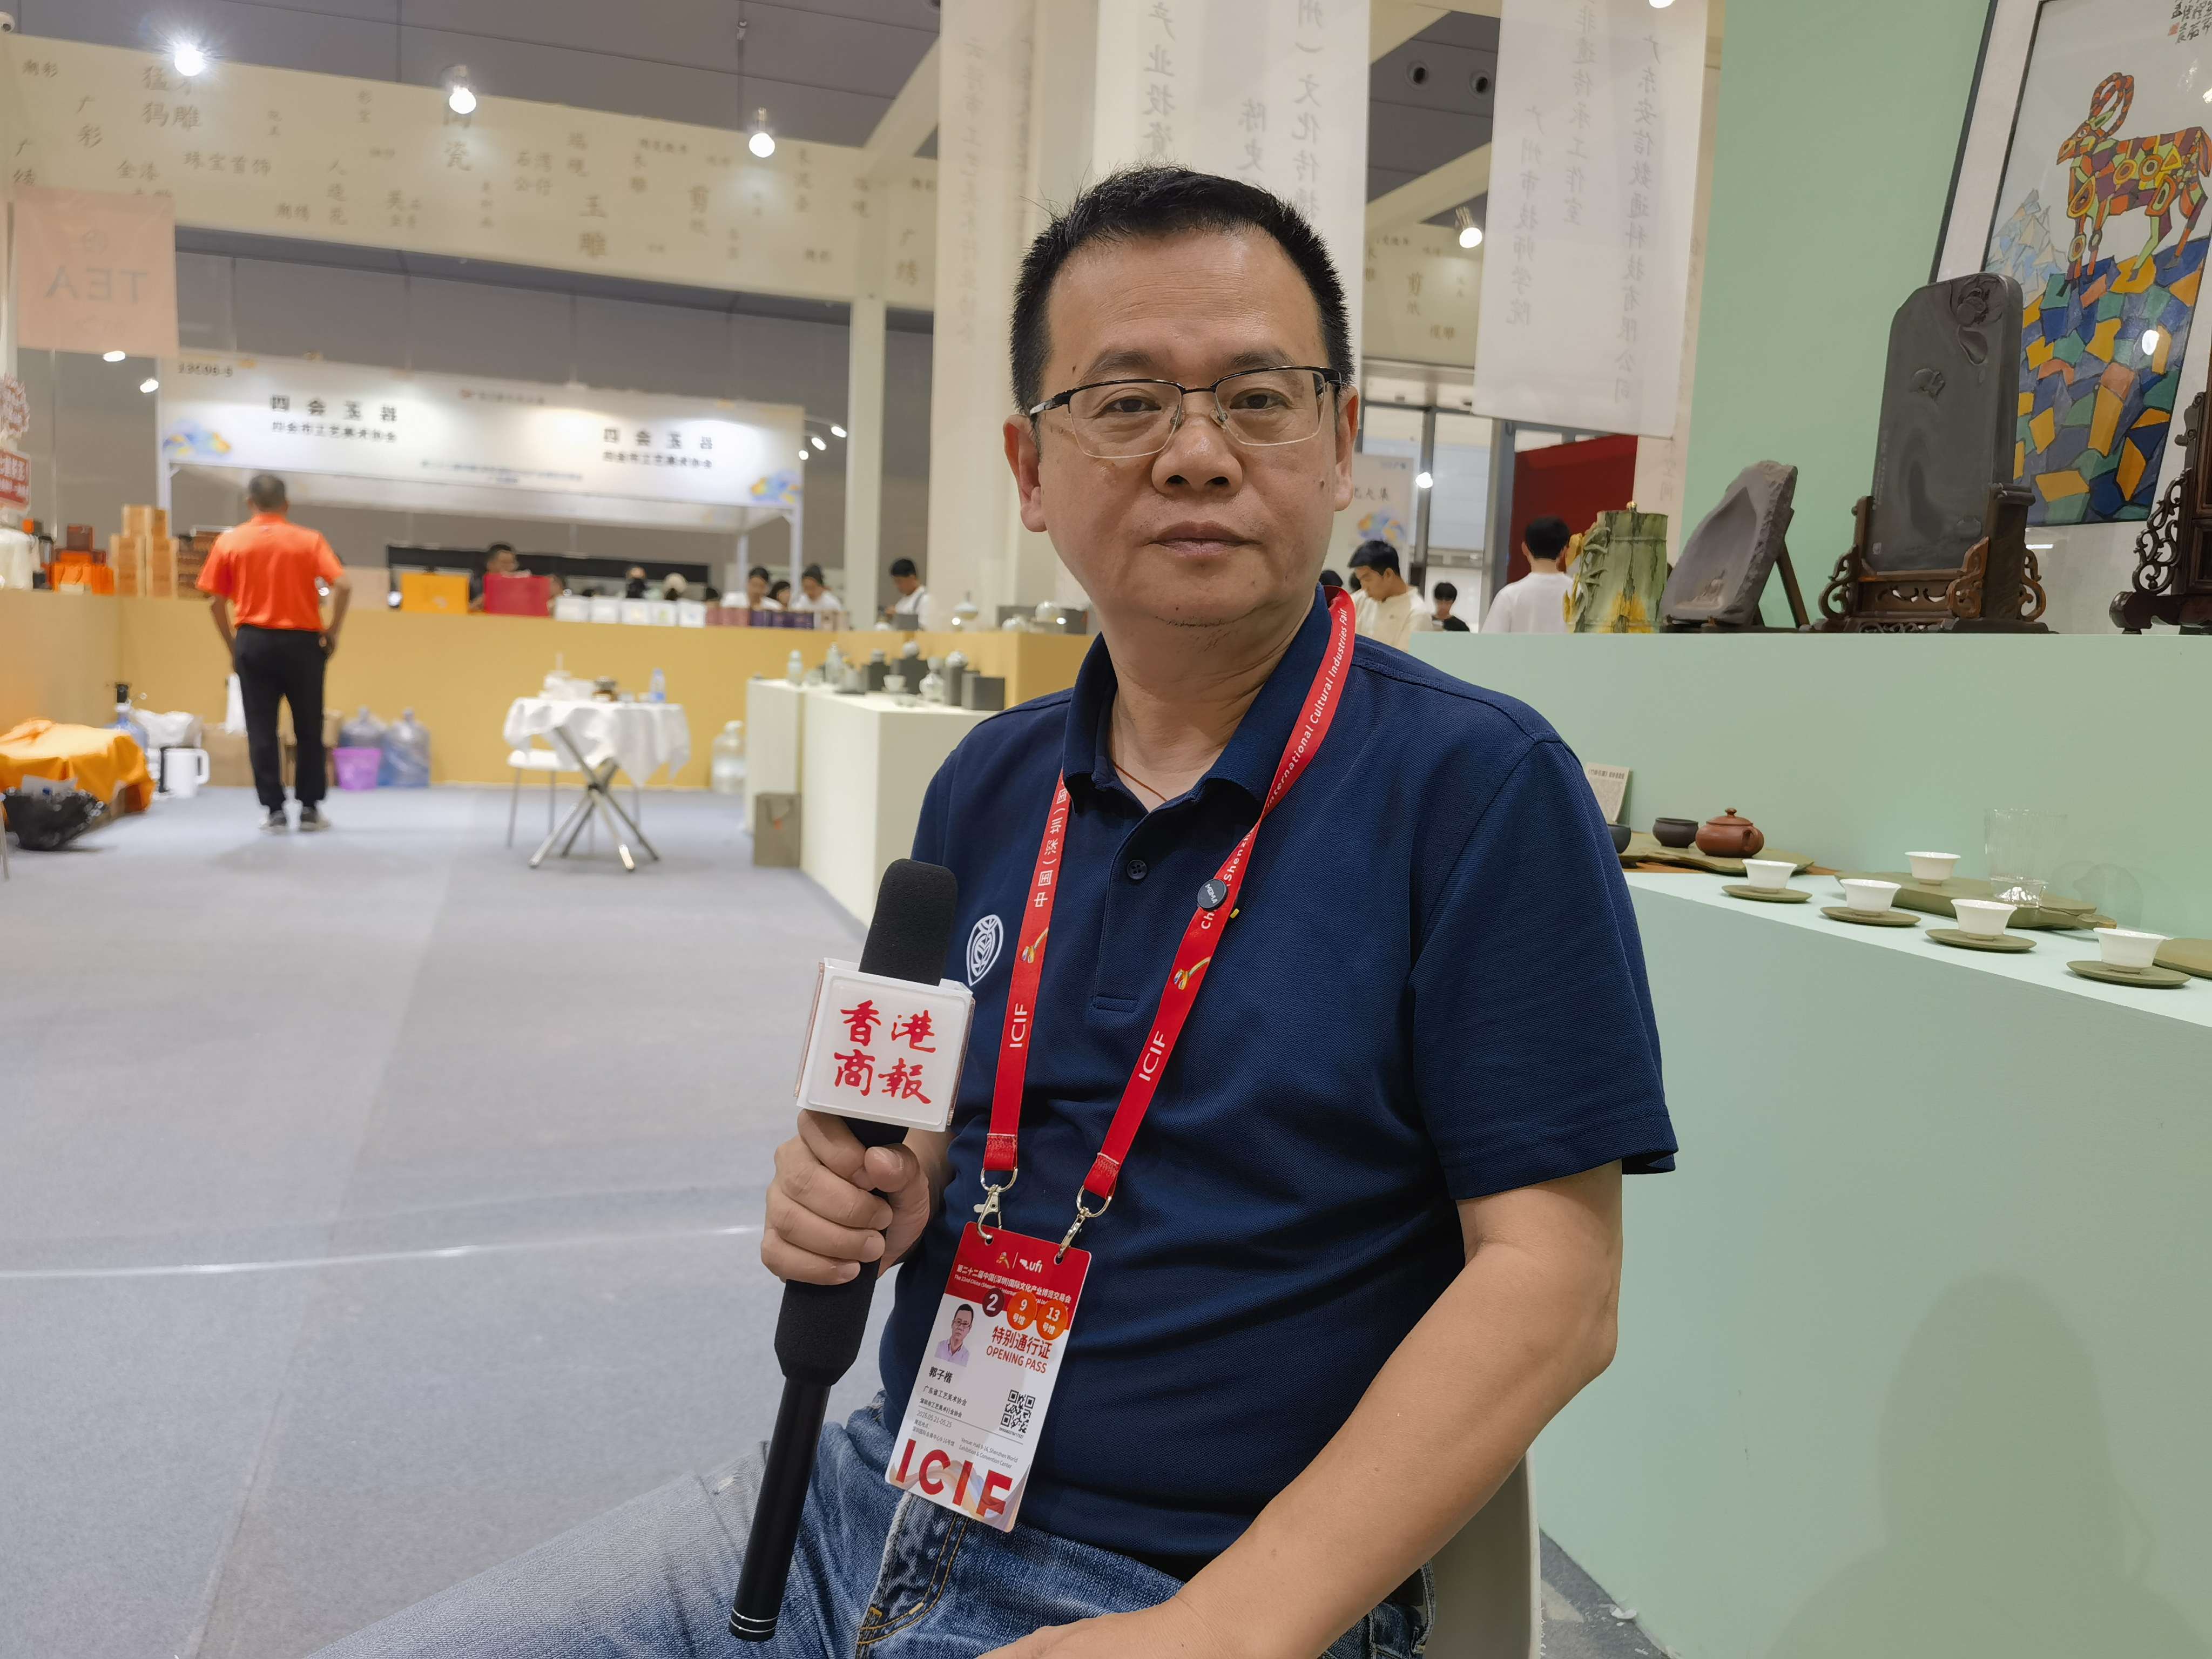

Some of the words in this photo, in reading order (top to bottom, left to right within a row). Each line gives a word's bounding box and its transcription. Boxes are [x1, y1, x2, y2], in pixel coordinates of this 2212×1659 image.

[1310, 678, 1334, 725] Cultural
[1328, 626, 1348, 678] Industries
[1339, 608, 1348, 626] Fair
[1034, 779, 1068, 908] 中国（深圳）国
[840, 1000, 936, 1053] 香港
[1009, 1003, 1028, 1048] ICIF
[1138, 1030, 1165, 1082] ICIF
[833, 1049, 932, 1104] 商報
[986, 1293, 999, 1312] 2
[1013, 1313, 1026, 1326] 号馆
[1020, 1298, 1028, 1311] 9
[1046, 1307, 1061, 1323] 13
[991, 1325, 1053, 1359] 特别通行证
[1042, 1322, 1056, 1335] 号馆
[986, 1345, 1024, 1366] OPENING
[1024, 1356, 1048, 1373] PASS
[923, 1385, 967, 1406] 广东省工艺美术协会
[895, 1438, 1013, 1518] ICIF
